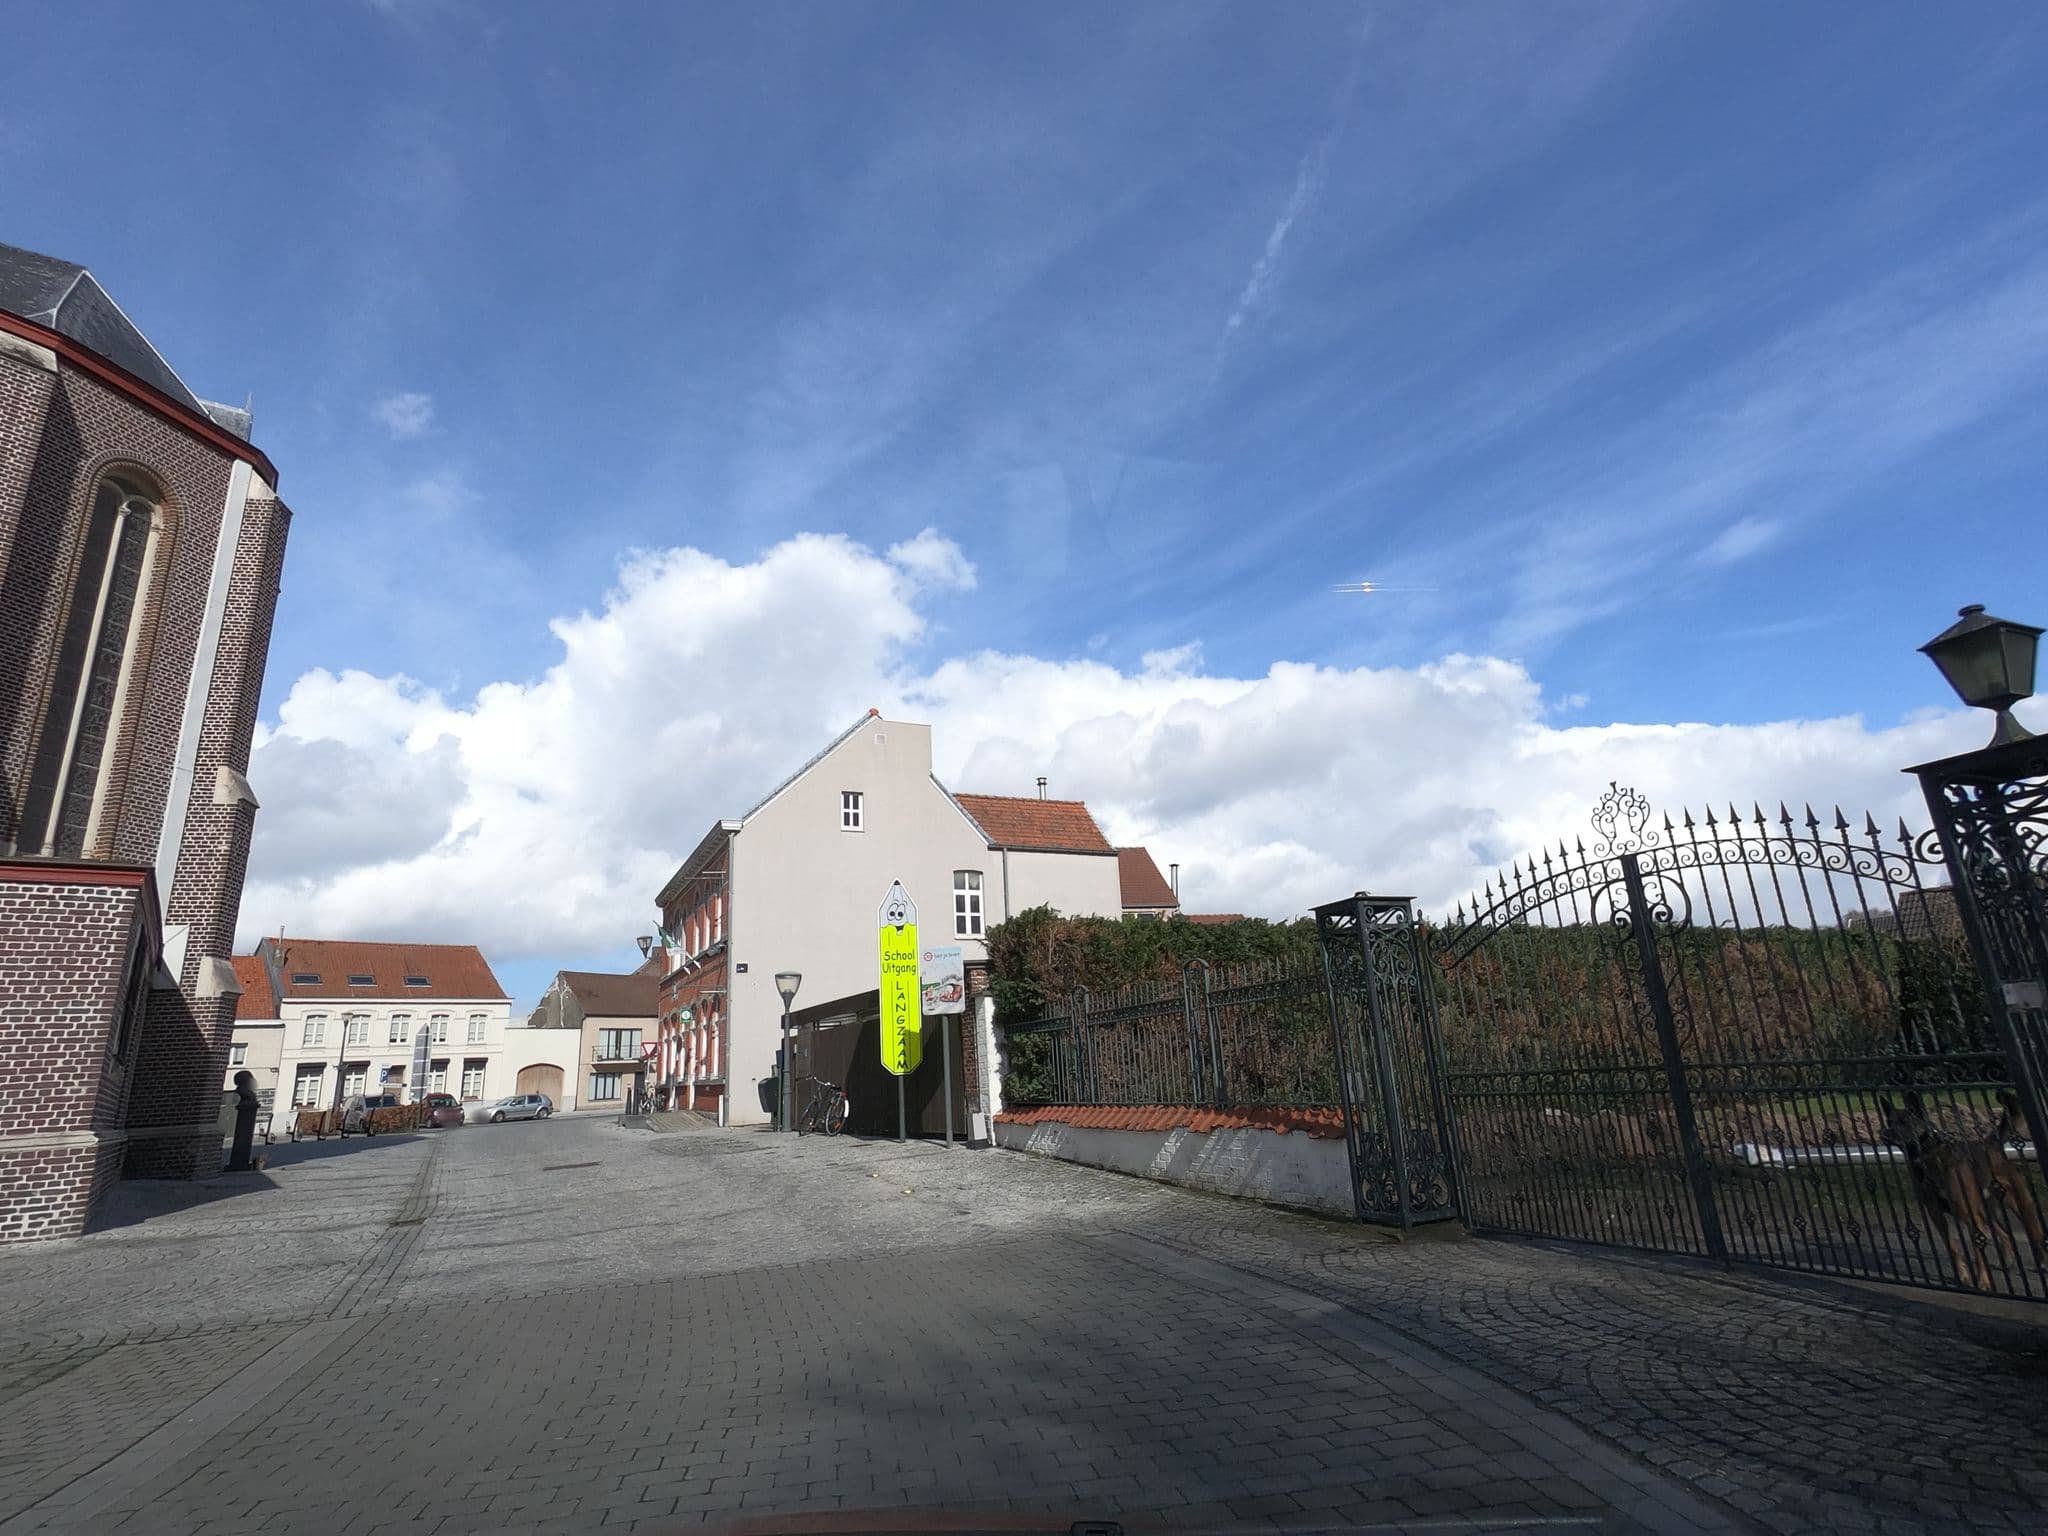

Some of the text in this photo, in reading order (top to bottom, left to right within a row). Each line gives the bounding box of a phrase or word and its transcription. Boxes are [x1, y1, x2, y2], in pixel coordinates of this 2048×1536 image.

[884, 950, 915, 961] School
[882, 963, 916, 976] Uitgang
[896, 981, 908, 1069] LANGZAAM
[380, 1070, 387, 1081] P
